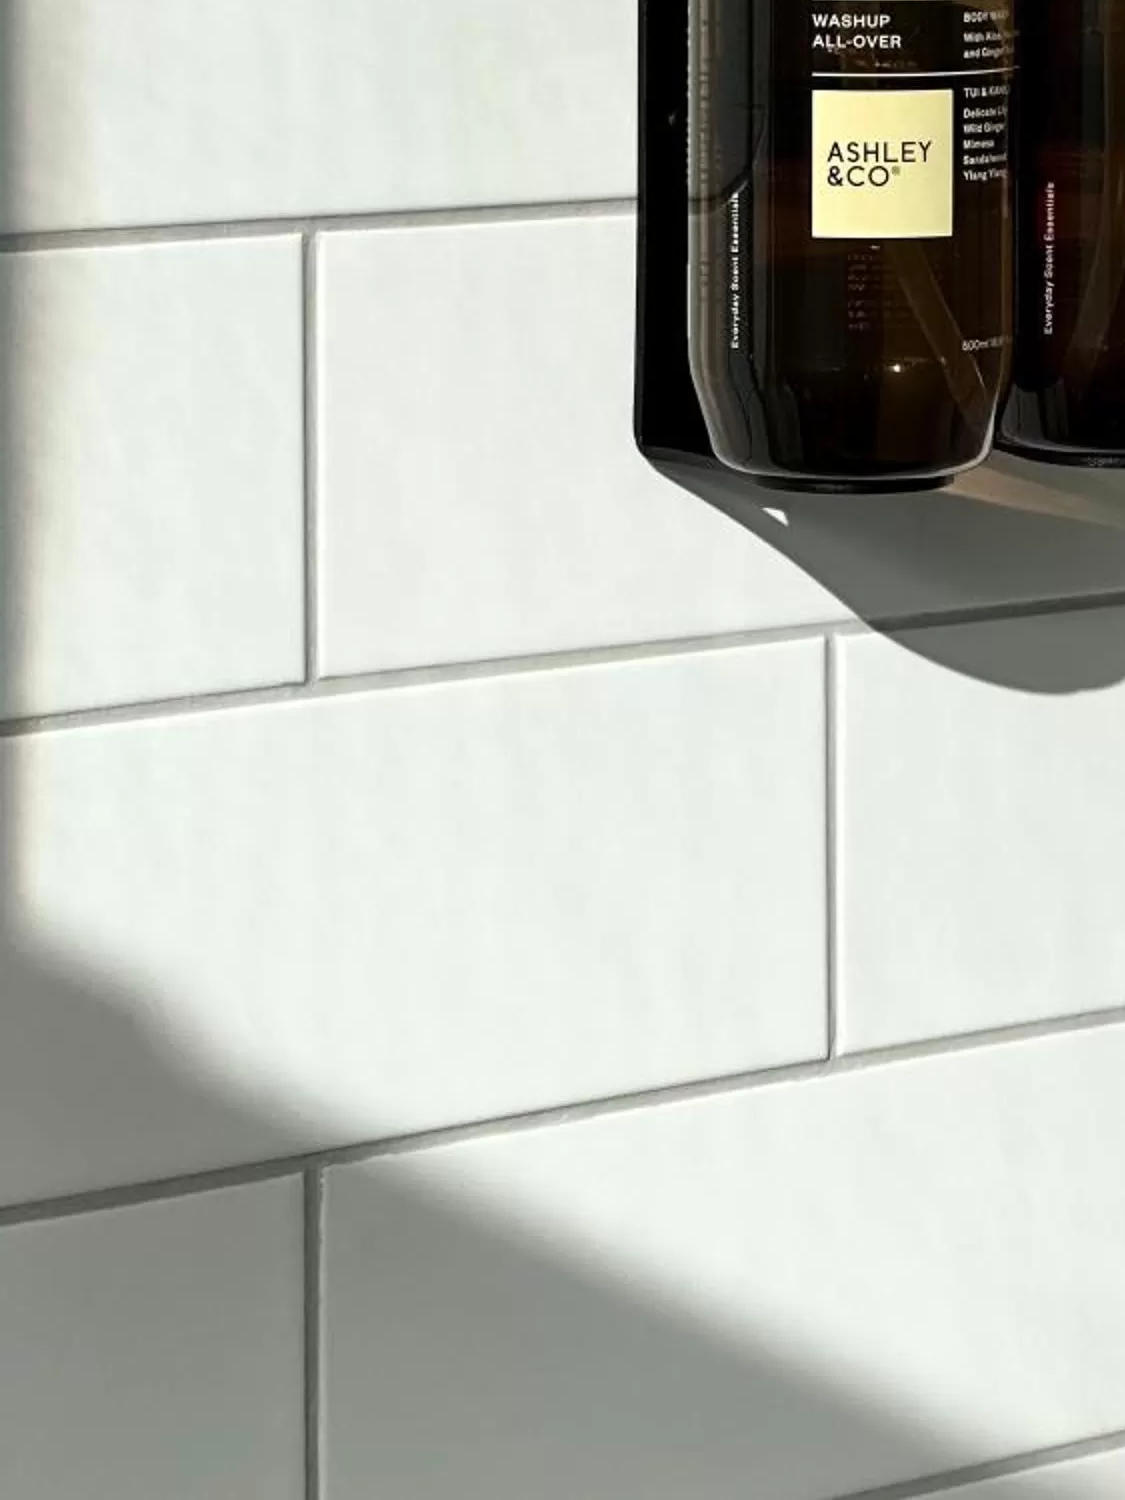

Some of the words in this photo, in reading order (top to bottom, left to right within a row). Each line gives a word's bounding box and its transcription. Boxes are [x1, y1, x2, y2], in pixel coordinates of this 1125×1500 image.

[811, 13, 891, 28] WASHUP
[811, 34, 902, 49] ALL-OVER
[963, 47, 980, 59] and
[963, 87, 980, 99] TUI
[981, 87, 987, 97] &
[827, 141, 932, 163] ASHLEY
[1043, 181, 1055, 241] Essentials
[730, 256, 740, 291] Scent
[1043, 244, 1054, 279] Scent
[730, 293, 741, 349] Everyday
[1043, 280, 1055, 335] Everyday
